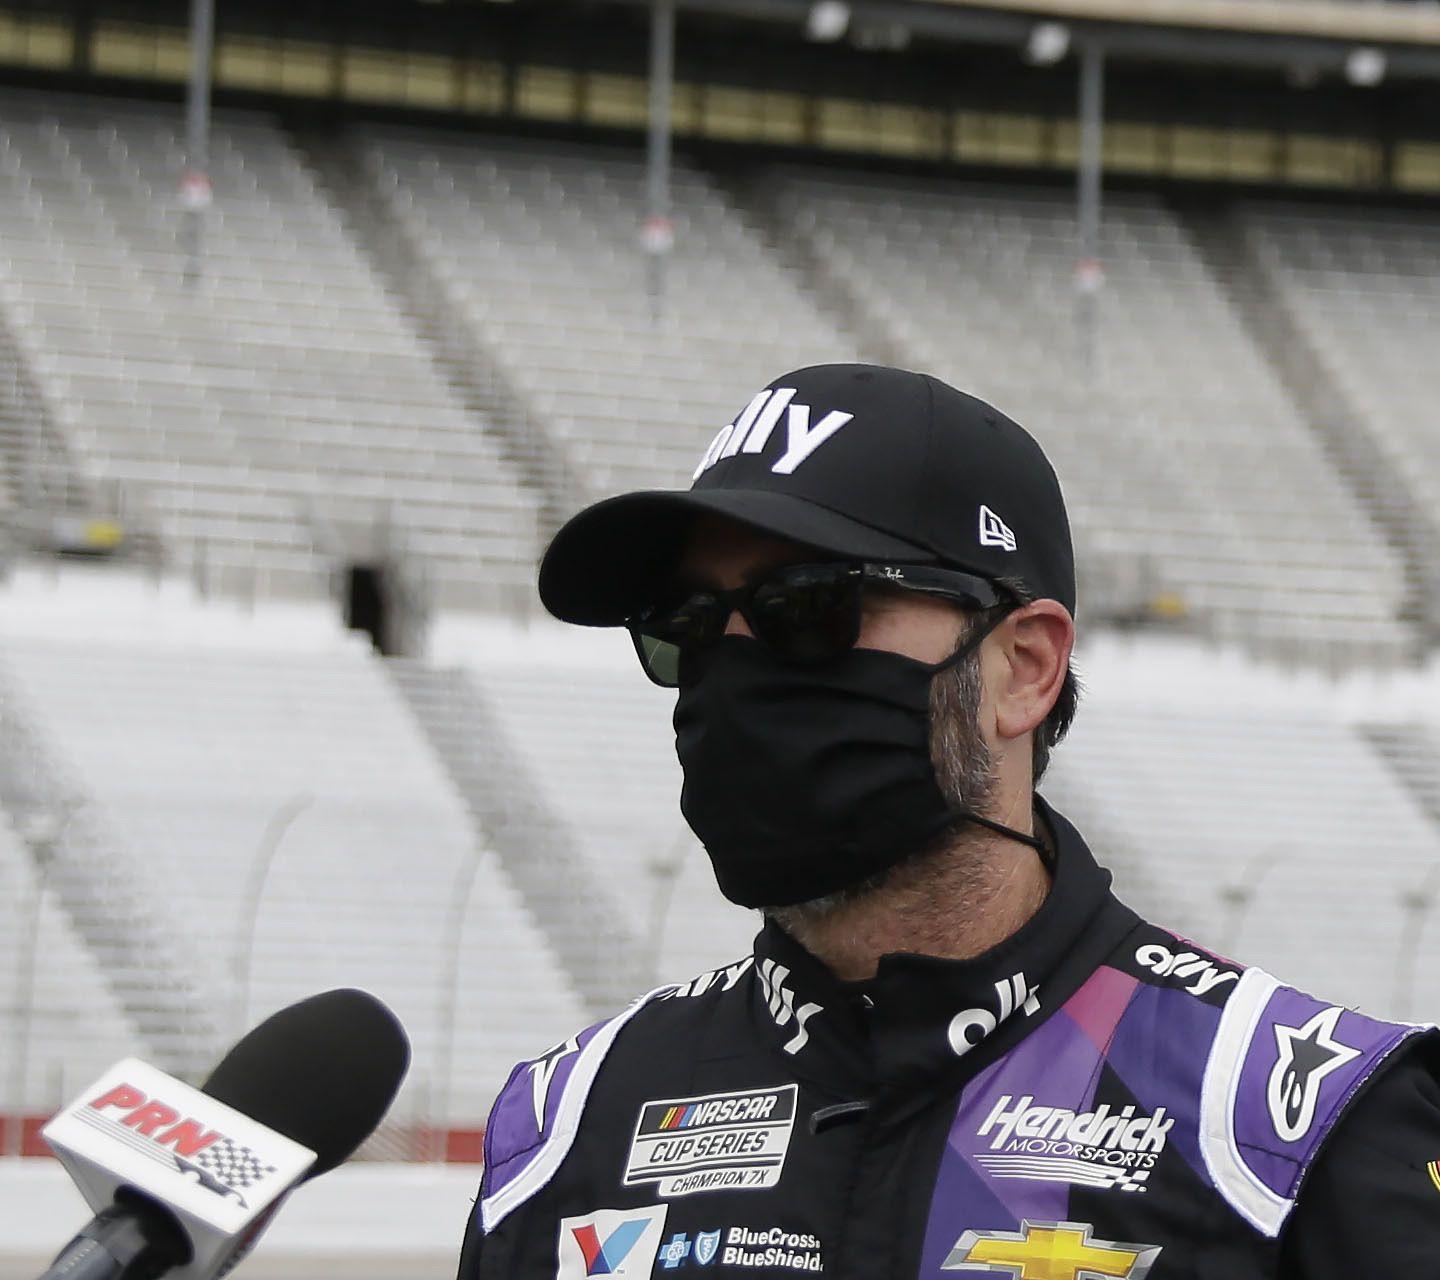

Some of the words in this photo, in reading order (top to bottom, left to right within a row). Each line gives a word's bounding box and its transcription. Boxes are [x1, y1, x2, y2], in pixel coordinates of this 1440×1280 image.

[88, 1081, 224, 1159] PRN
[687, 1095, 778, 1127] NASCAR
[976, 1094, 1176, 1153] Hendrick
[649, 1137, 695, 1163] CUP
[693, 1130, 770, 1158] SERIES
[1005, 1138, 1160, 1169] MOTORSPORTS
[670, 1170, 748, 1194] CHAMPION
[747, 1169, 770, 1185] 7X
